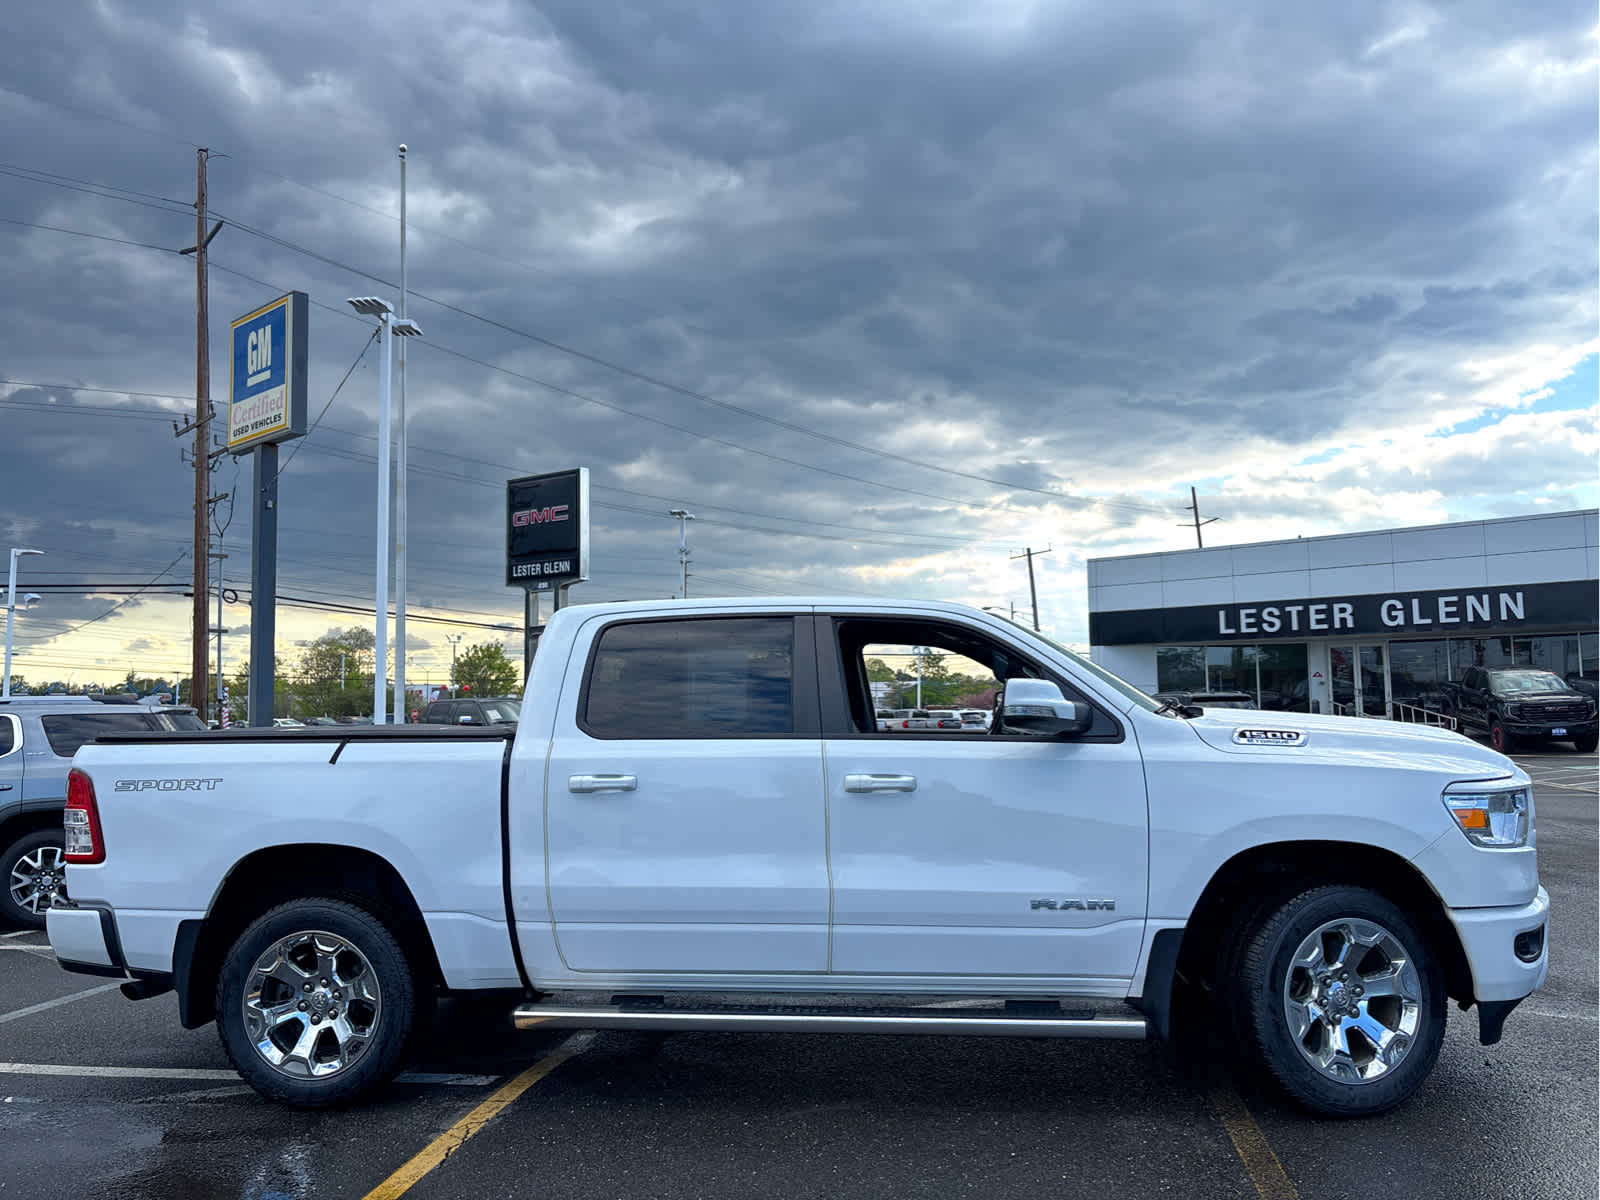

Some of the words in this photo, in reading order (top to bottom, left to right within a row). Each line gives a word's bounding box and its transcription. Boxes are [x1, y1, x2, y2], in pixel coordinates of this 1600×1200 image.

[248, 325, 271, 374] GM
[232, 391, 283, 425] Certified
[233, 424, 249, 437] USED
[250, 413, 281, 430] VEHICLES
[513, 505, 568, 526] GMC
[513, 564, 541, 577] LESTER
[544, 560, 570, 574] GLENN
[1218, 602, 1355, 635] LESTER
[1380, 591, 1526, 627] GLENN
[1243, 731, 1297, 740] 1500
[114, 778, 223, 792] SPORT
[1031, 899, 1116, 911] RAM
